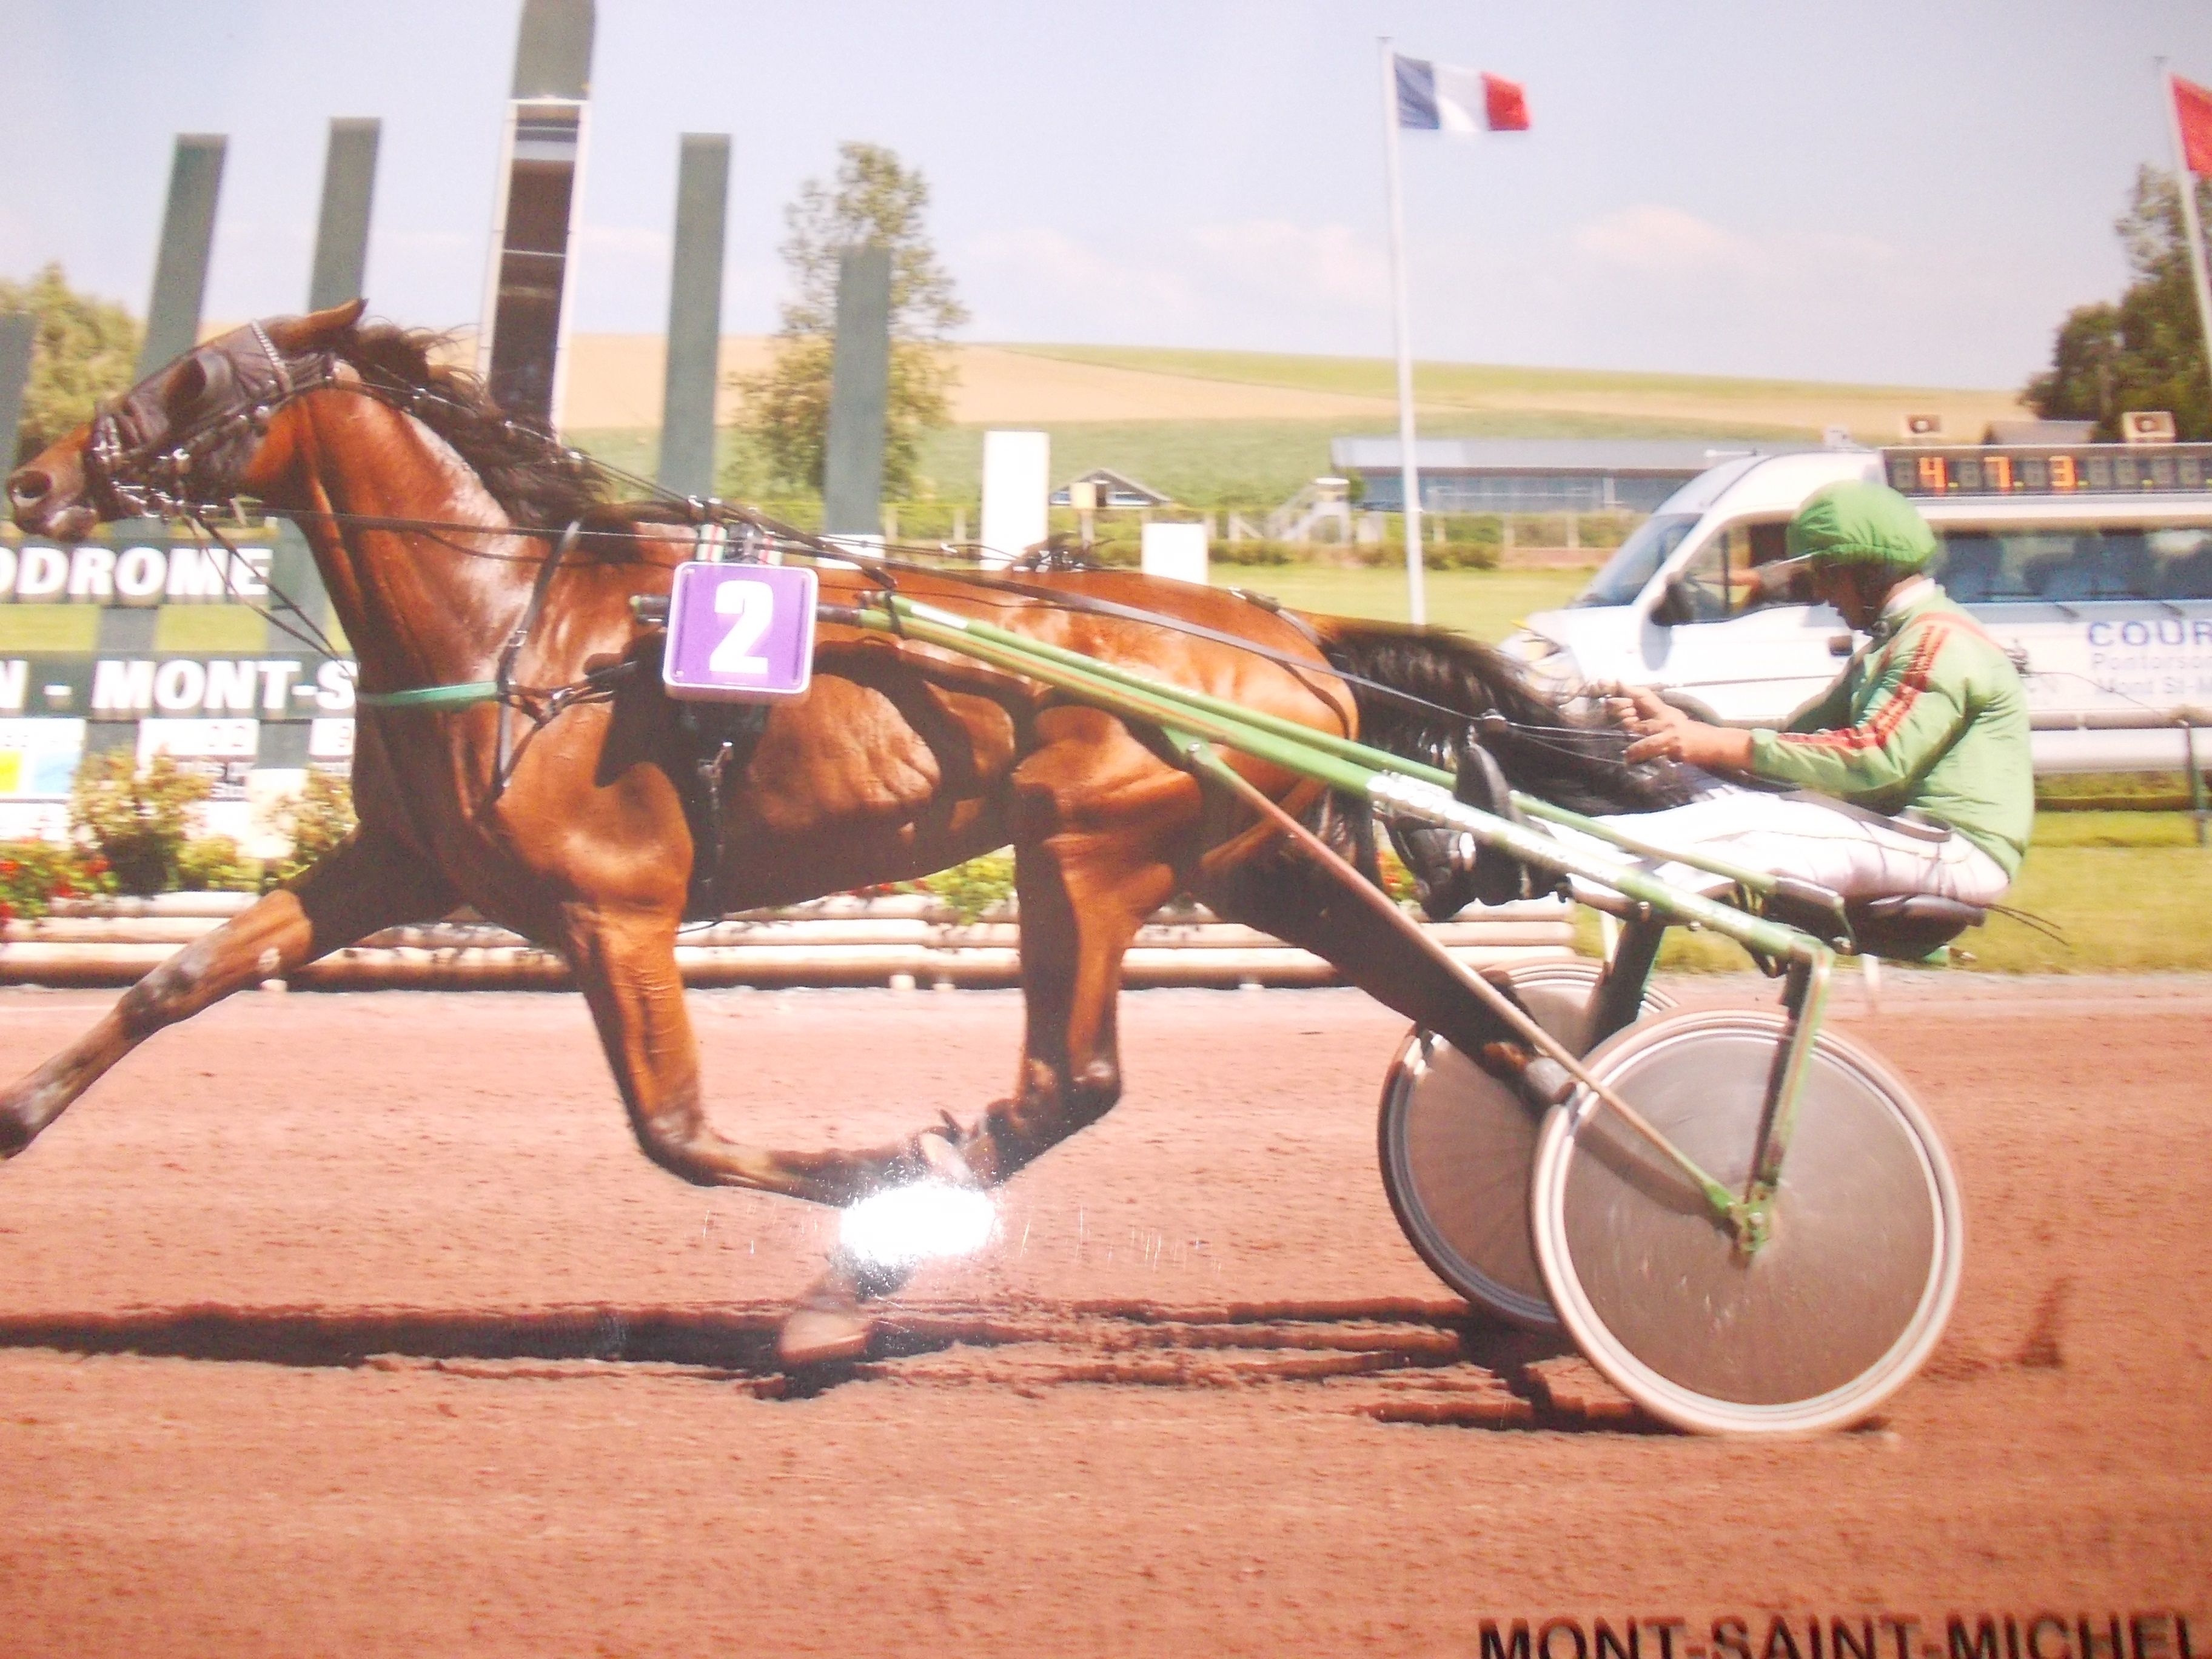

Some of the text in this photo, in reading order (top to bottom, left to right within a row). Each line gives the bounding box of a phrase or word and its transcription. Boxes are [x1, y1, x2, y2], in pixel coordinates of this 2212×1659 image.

[1918, 456, 1947, 489] 4
[2048, 455, 2077, 489] 3
[709, 580, 774, 675] 2
